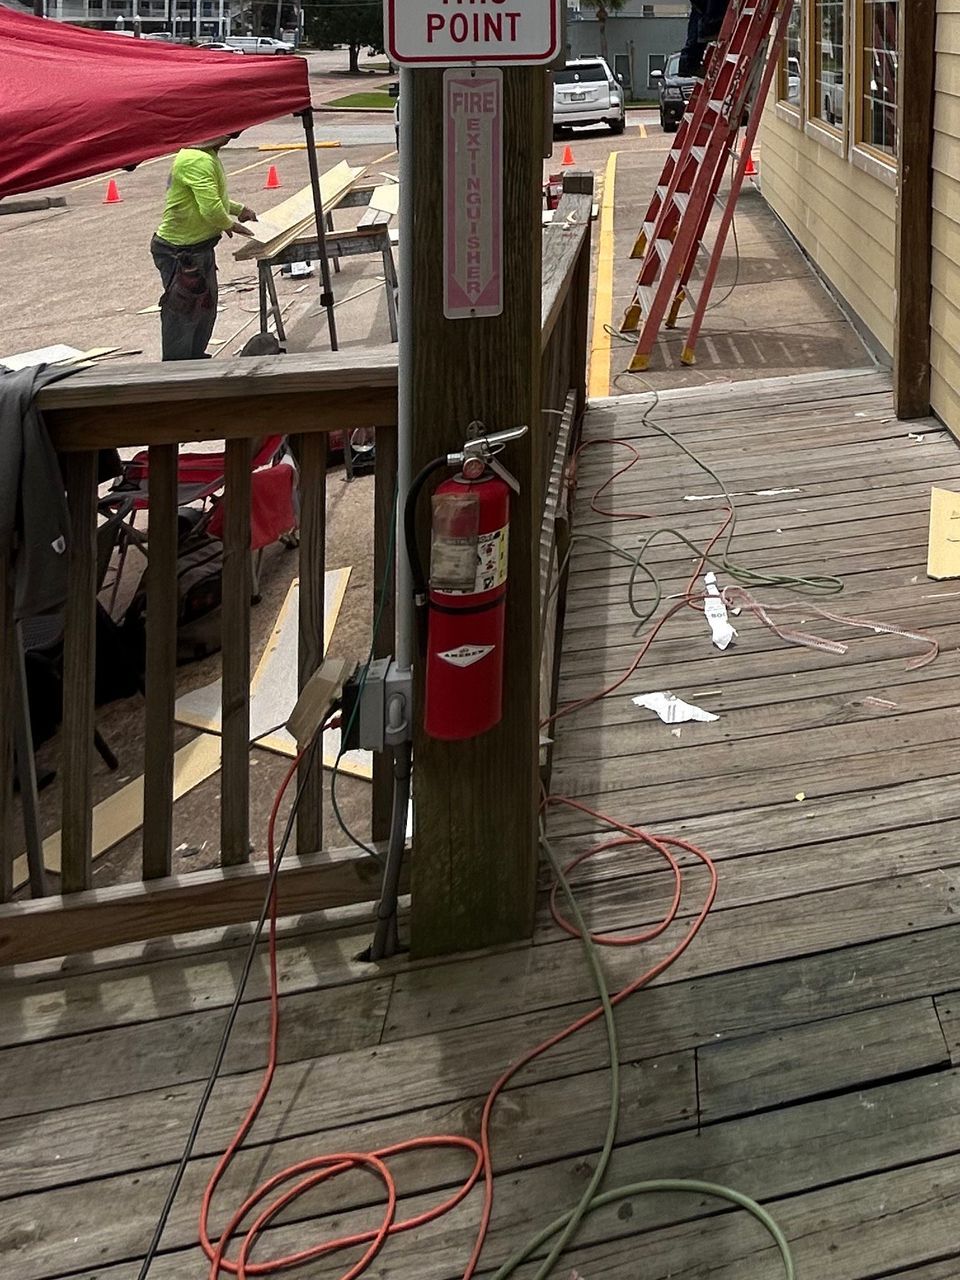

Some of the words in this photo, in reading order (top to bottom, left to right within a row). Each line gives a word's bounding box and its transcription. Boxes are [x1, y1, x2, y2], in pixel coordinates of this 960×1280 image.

[426, 12, 522, 44] POINT
[452, 92, 495, 114] FIRE
[466, 118, 481, 295] EXTINGUISHER
